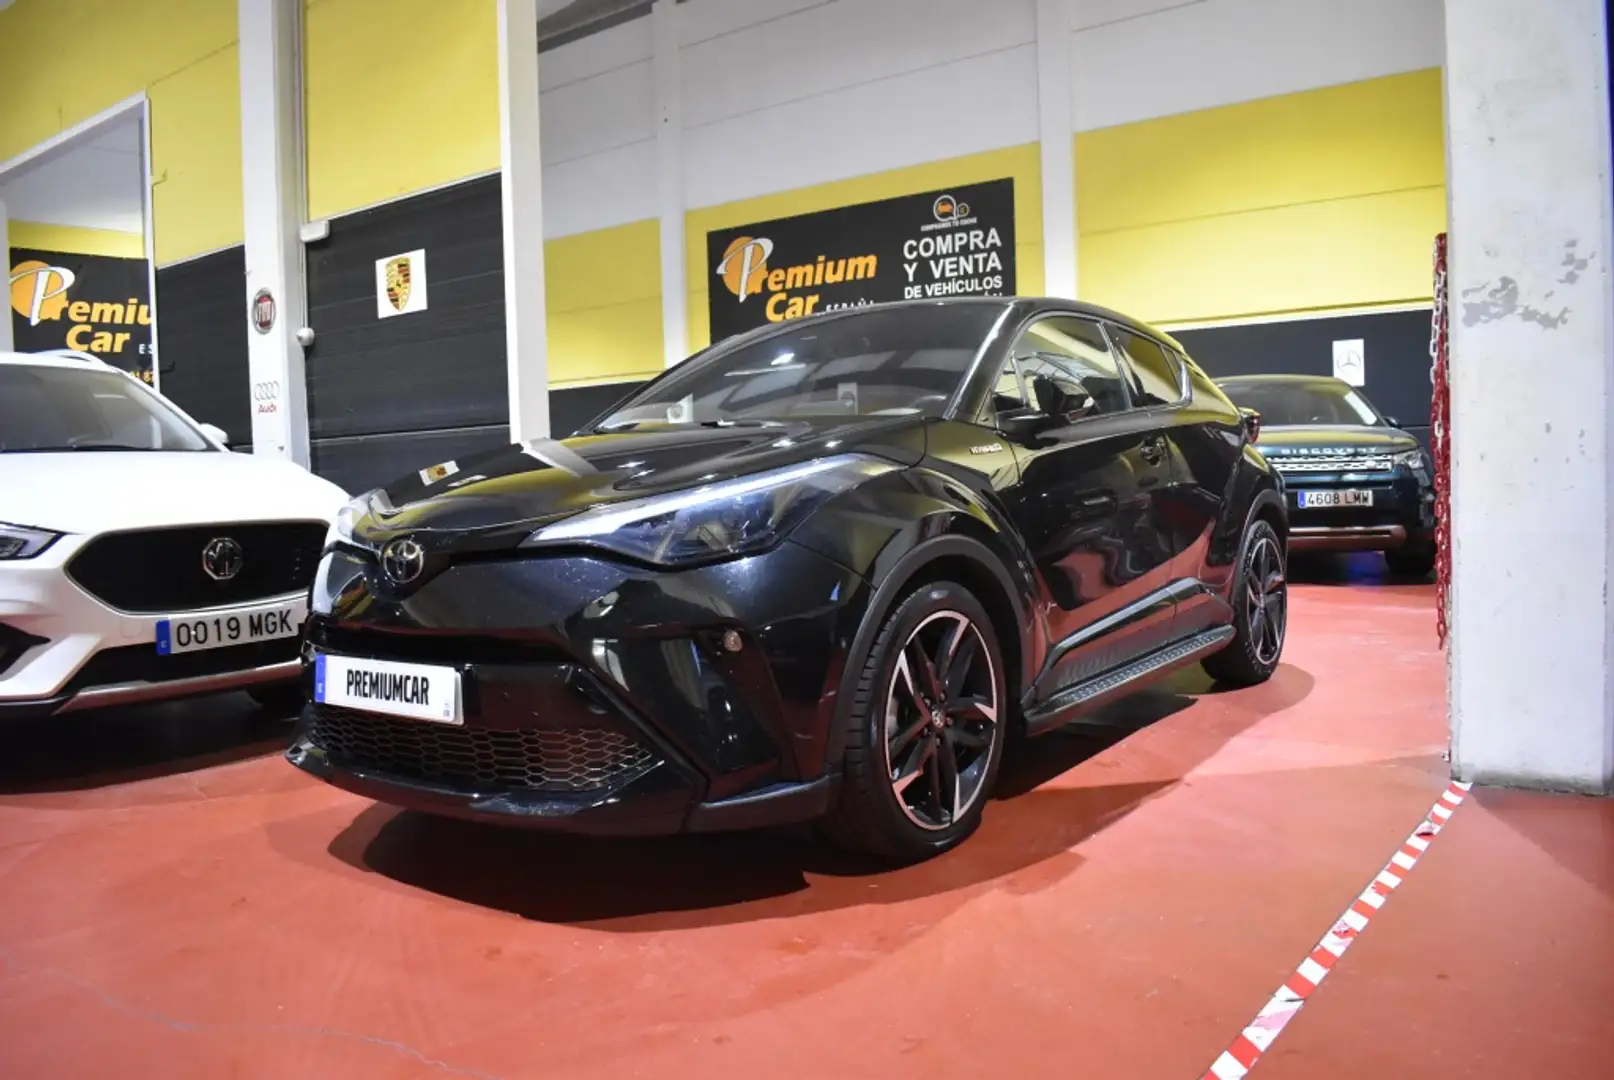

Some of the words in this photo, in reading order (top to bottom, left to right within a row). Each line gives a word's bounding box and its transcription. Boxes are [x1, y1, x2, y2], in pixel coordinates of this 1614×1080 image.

[903, 227, 1002, 260] COMPRA
[716, 237, 877, 303] Premium
[903, 262, 918, 282] Y
[929, 251, 1002, 279] VENTA
[9, 266, 152, 326] Premiu
[904, 285, 922, 299] DE
[925, 275, 1003, 297] VEHÍCULOS
[766, 292, 819, 323] Car
[66, 324, 130, 353] Car
[1281, 446, 1377, 455] DISCOVERY
[1307, 491, 1341, 505] 4608
[1344, 489, 1369, 504] LMW
[176, 616, 240, 647] 0019
[249, 609, 292, 637] MGK
[346, 669, 429, 705] PREMIUMCAR
